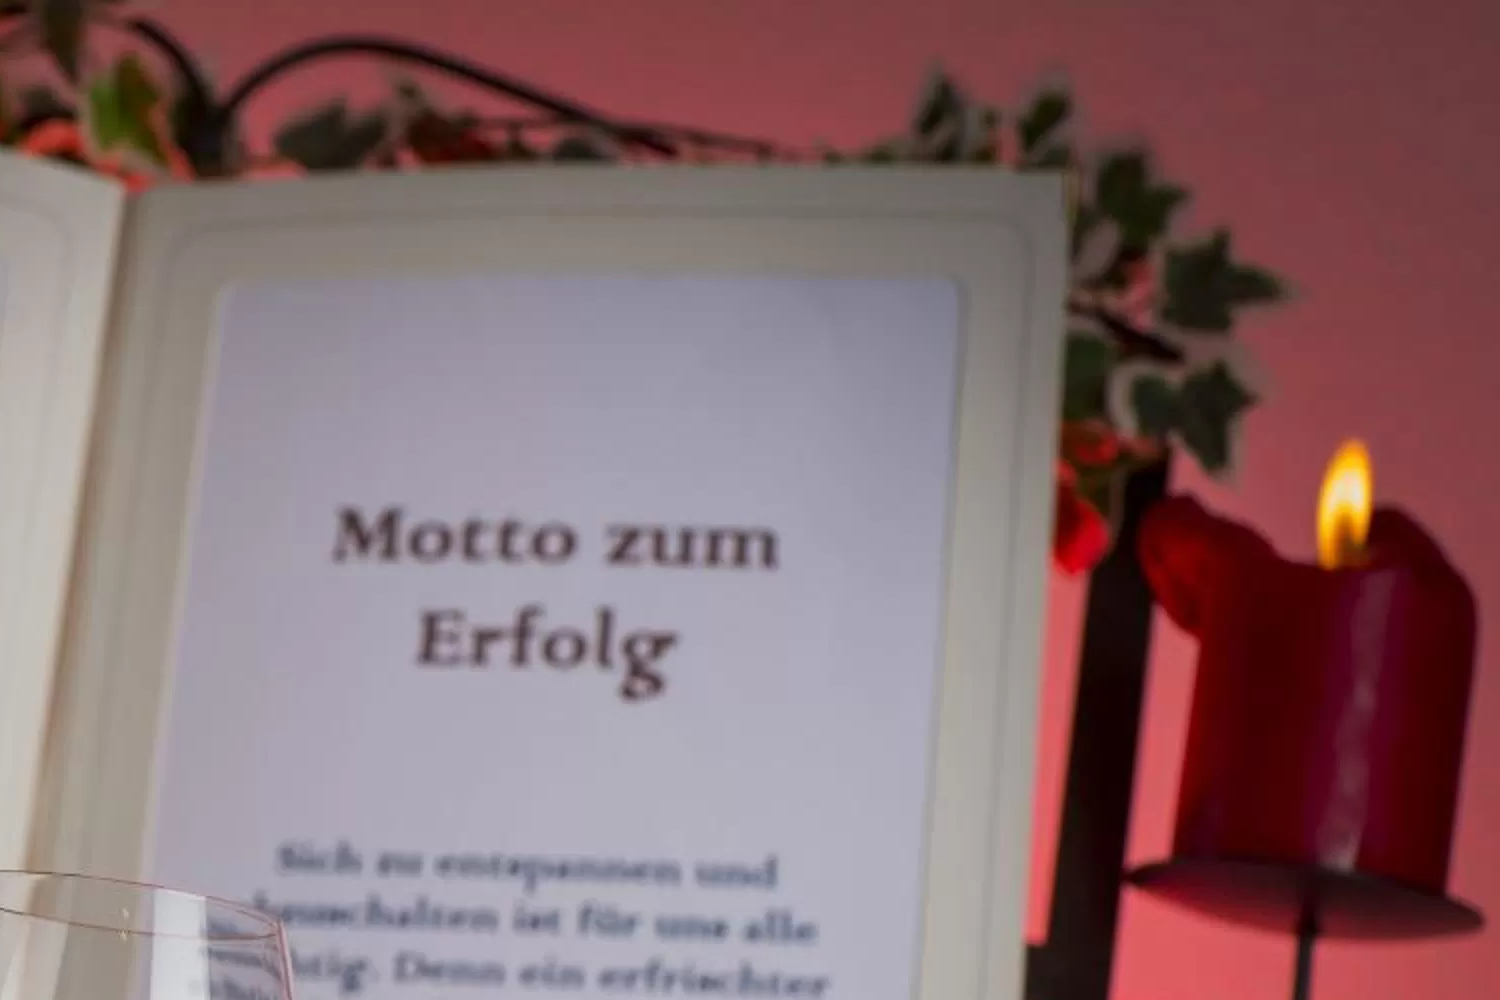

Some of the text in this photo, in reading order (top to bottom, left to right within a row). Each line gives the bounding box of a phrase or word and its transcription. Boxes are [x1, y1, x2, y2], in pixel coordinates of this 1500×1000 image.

[332, 506, 780, 571] Motto zum
[416, 603, 680, 702] Erfolg
[276, 841, 778, 894] Sich zu entspannen und
[513, 901, 560, 935] ist
[578, 899, 639, 939] für
[655, 914, 728, 942] uns
[744, 906, 819, 945] alle
[393, 951, 505, 984] Denn
[518, 956, 585, 989] ein
[598, 956, 831, 1000] erfrischter
